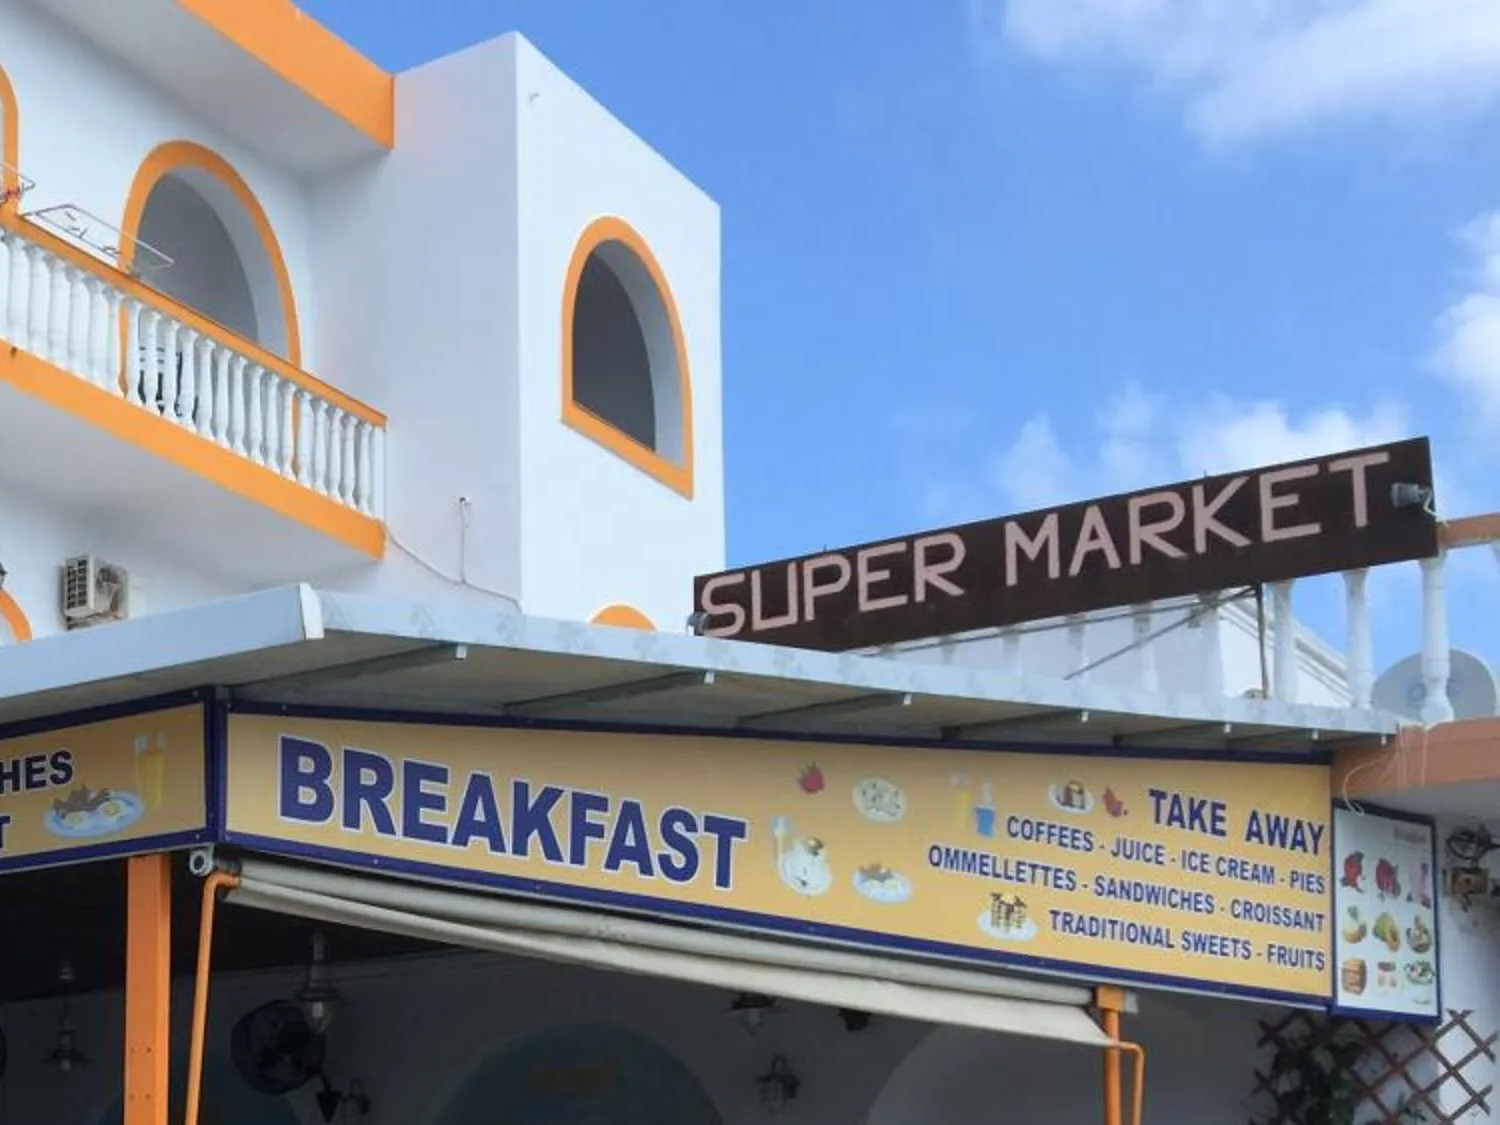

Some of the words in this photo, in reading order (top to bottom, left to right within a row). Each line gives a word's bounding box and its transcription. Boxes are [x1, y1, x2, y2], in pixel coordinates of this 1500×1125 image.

[700, 532, 966, 638] SUPER
[1004, 451, 1391, 586] MARKET
[280, 735, 746, 889] BREAKFAST
[1149, 788, 1227, 837] TAKE
[1245, 809, 1325, 856] AWAY
[928, 845, 1077, 892] OMMELLETTES
[1094, 874, 1215, 915] SANDWICHES
[1230, 898, 1324, 933] CROISSANT
[1006, 815, 1094, 852] COFFEES
[1110, 837, 1165, 866] JUICE
[1181, 849, 1210, 875] ICE
[1215, 856, 1275, 886] CREAM
[1289, 870, 1326, 895] PIES
[1049, 909, 1175, 949] TRADITIONAL
[1181, 930, 1252, 960] SWEETS
[1267, 943, 1326, 972] FRUITS
